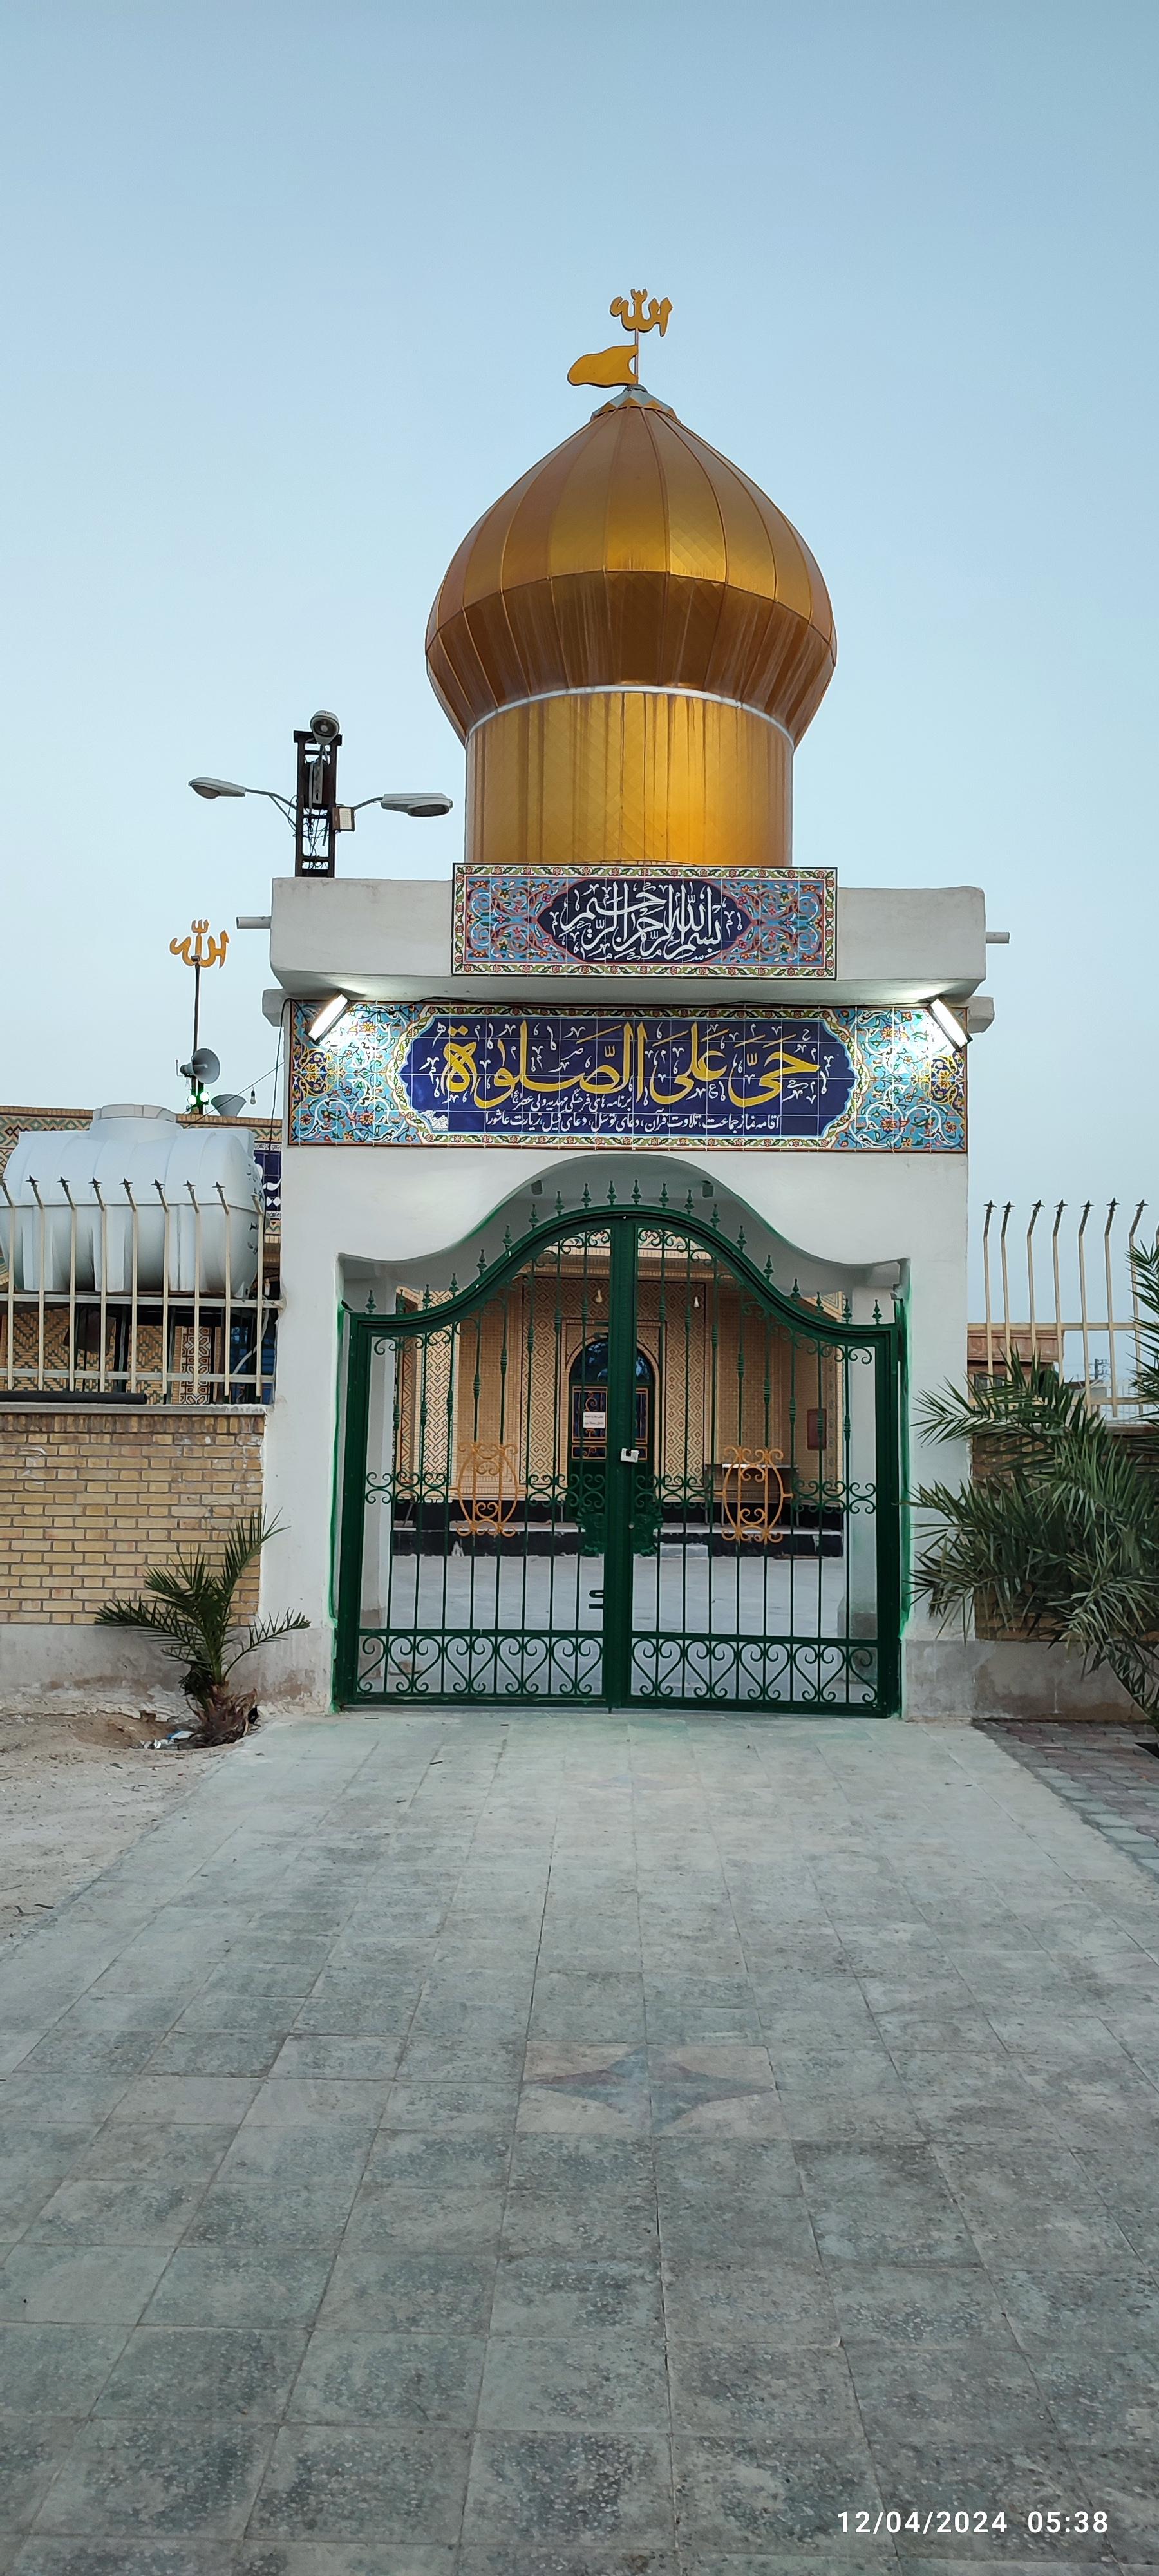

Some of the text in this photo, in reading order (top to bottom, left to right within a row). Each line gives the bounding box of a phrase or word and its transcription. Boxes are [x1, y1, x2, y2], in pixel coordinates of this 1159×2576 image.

[565, 1089, 592, 1113] فرهنگی
[607, 1094, 632, 1111] برنامه
[485, 1108, 511, 1126] عاشورا
[510, 1113, 541, 1130] زیارت
[561, 1113, 587, 1132] دعای
[616, 1113, 639, 1132] دعای
[666, 1113, 702, 1128] تلاوت
[735, 1113, 756, 1130] نماز
